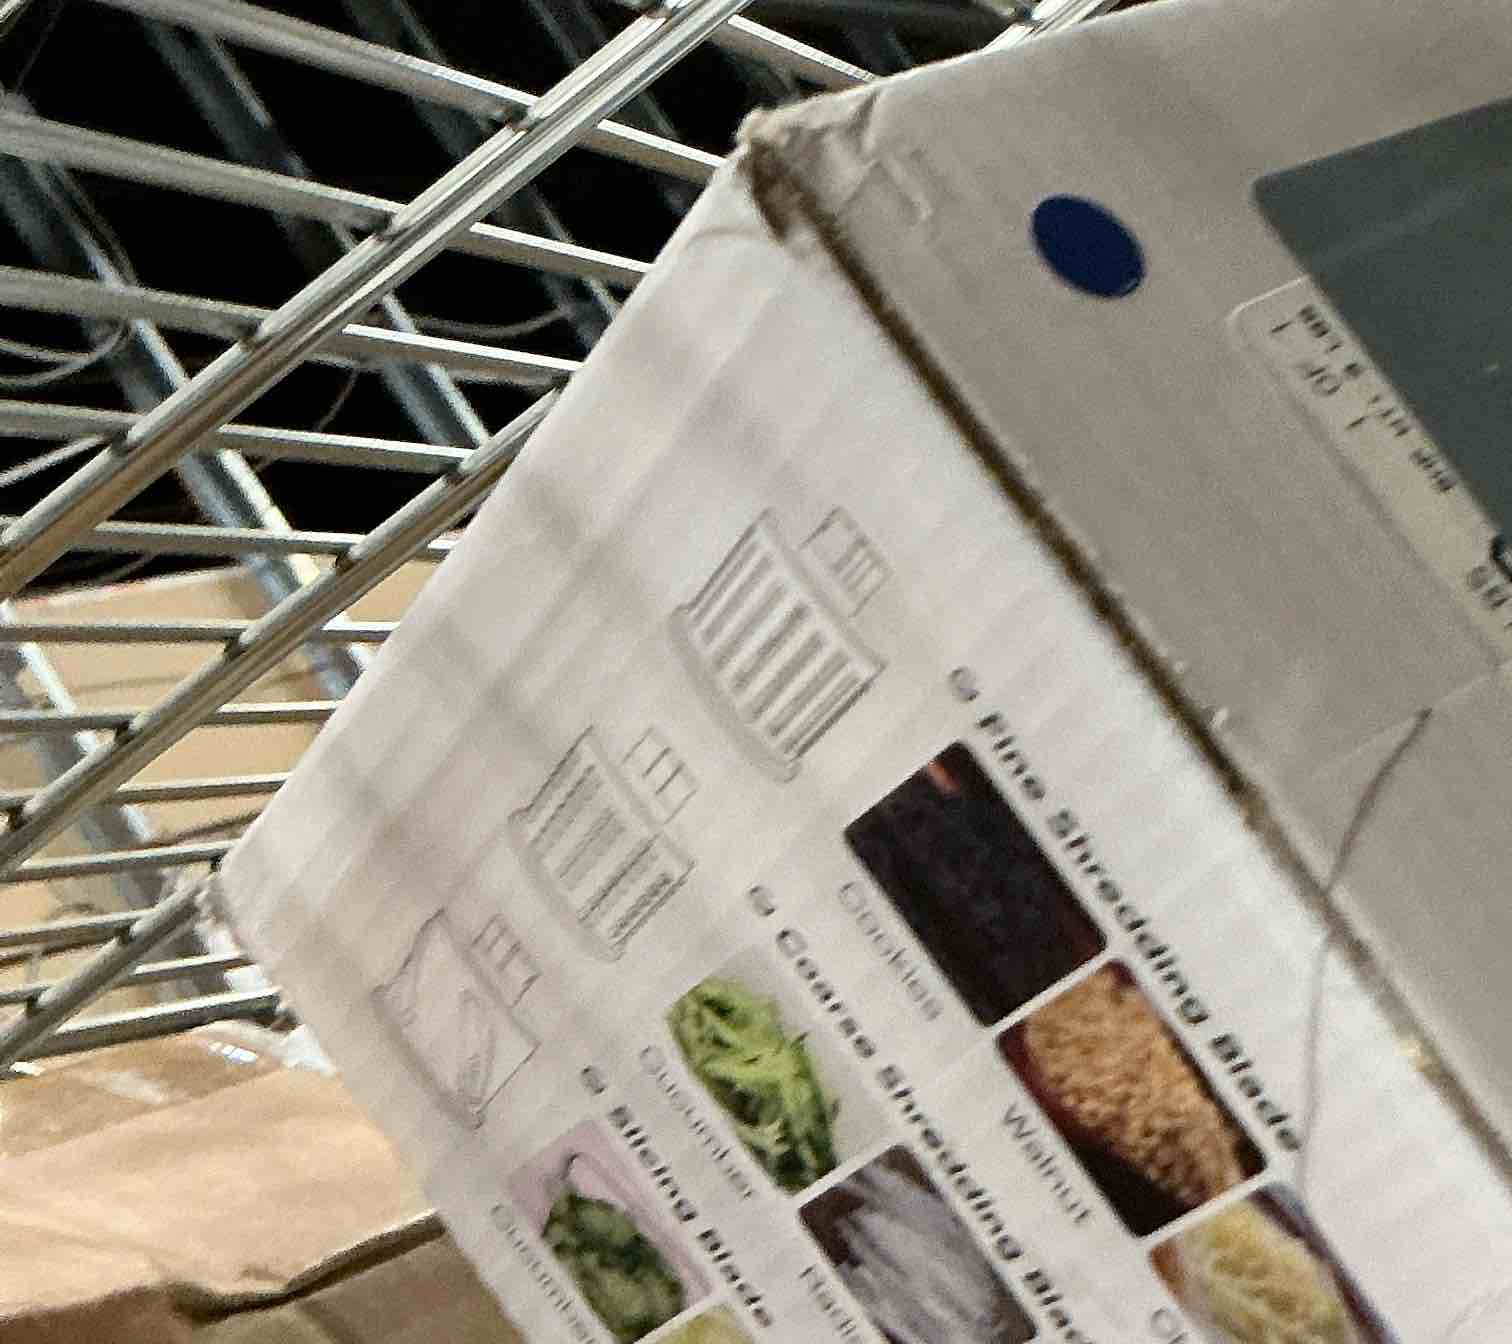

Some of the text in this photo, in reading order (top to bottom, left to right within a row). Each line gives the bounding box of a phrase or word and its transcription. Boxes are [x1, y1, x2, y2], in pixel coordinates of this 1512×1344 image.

[975, 710, 1301, 1153] Fine Shredding Blade
[606, 1104, 774, 1329] Slicing Blade
[775, 928, 878, 1059] Coarse
[876, 1063, 1026, 1263] Shredding
[1002, 1102, 1093, 1225] Walnut
